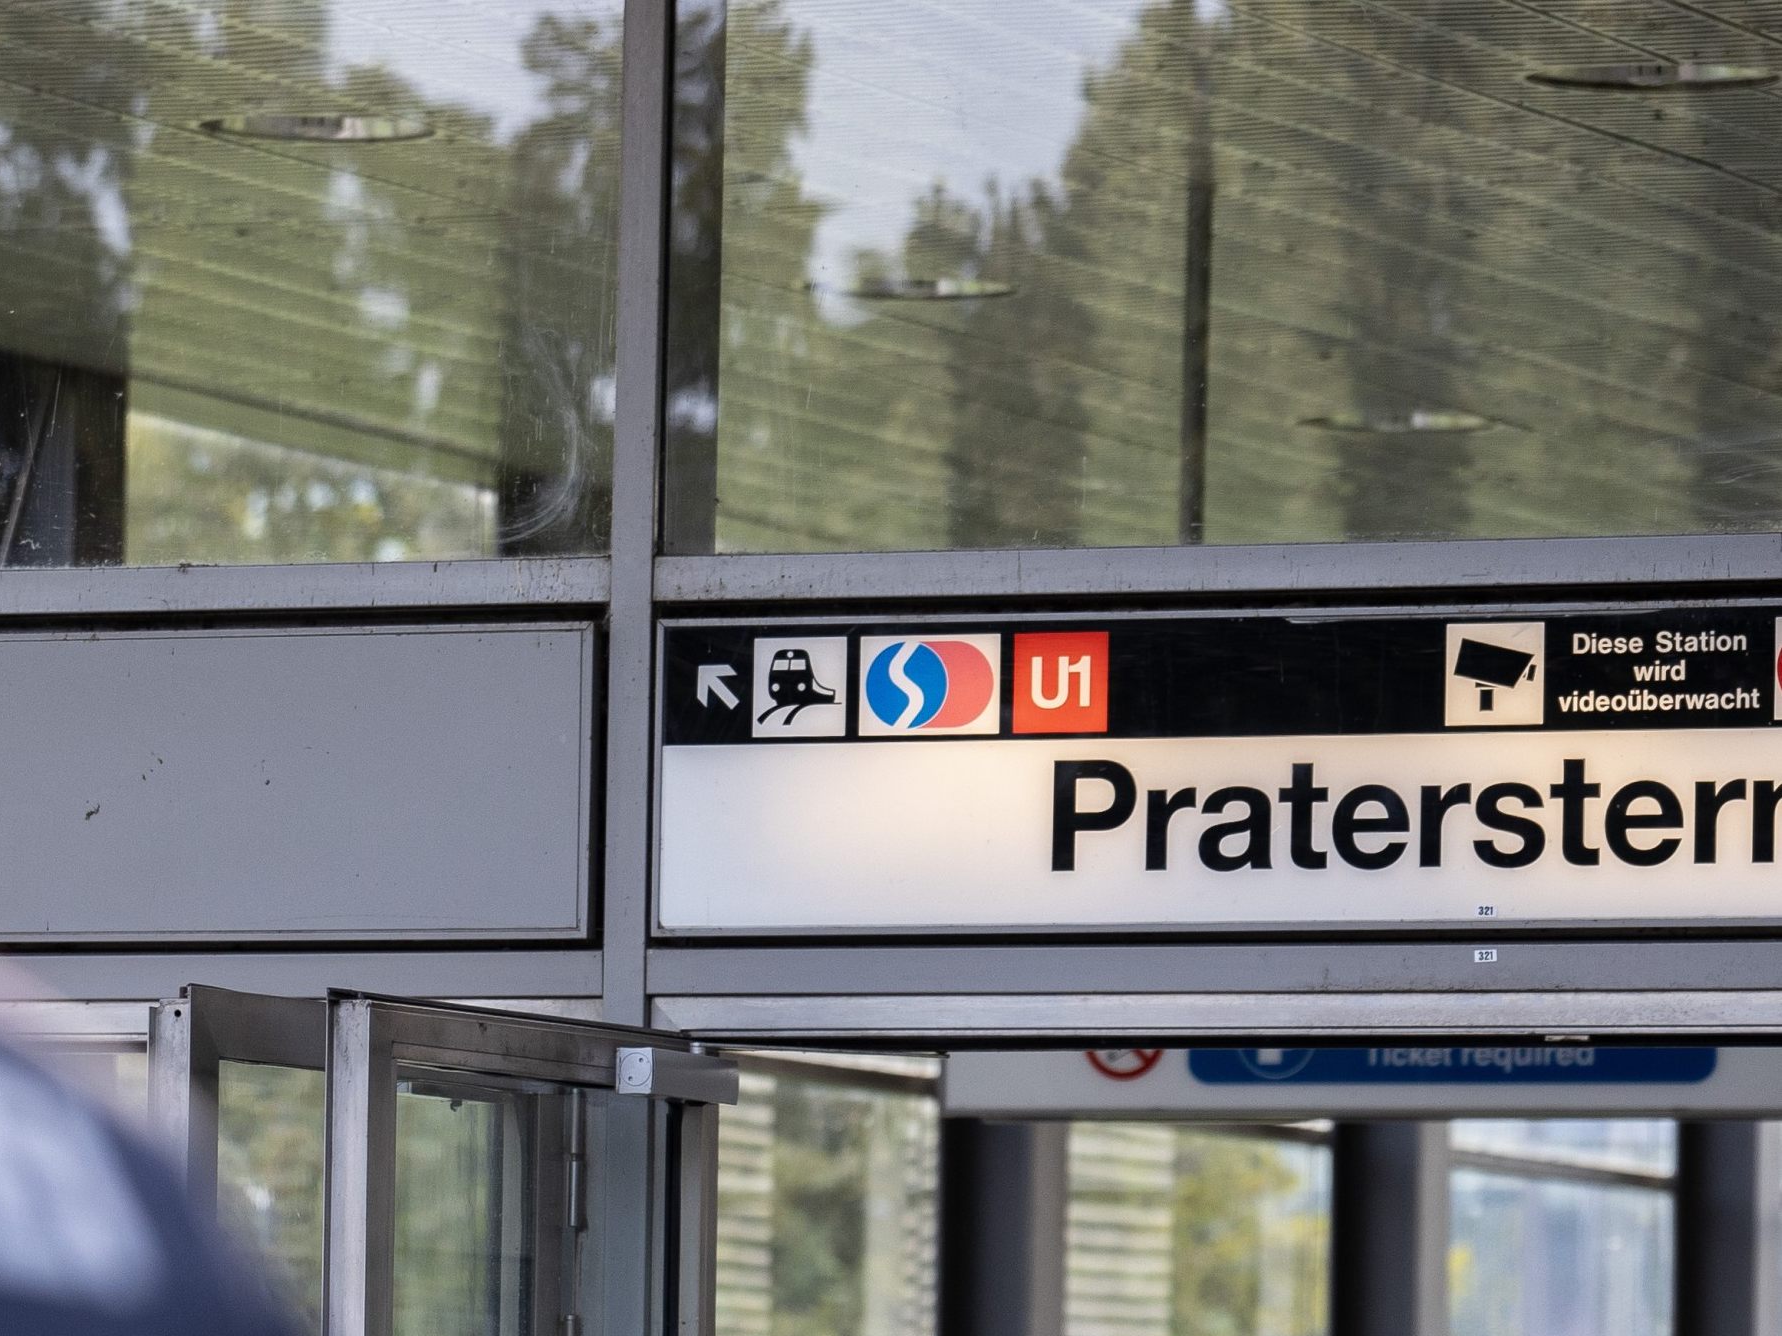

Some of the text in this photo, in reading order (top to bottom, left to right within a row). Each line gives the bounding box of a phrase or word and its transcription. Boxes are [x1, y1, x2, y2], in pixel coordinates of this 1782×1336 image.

[1573, 631, 1747, 654] Diese Station
[1633, 659, 1686, 681] wird
[1031, 656, 1091, 709] U1
[1558, 688, 1760, 713] videoüberwacht
[1478, 906, 1494, 916] 321
[1478, 951, 1494, 961] 321
